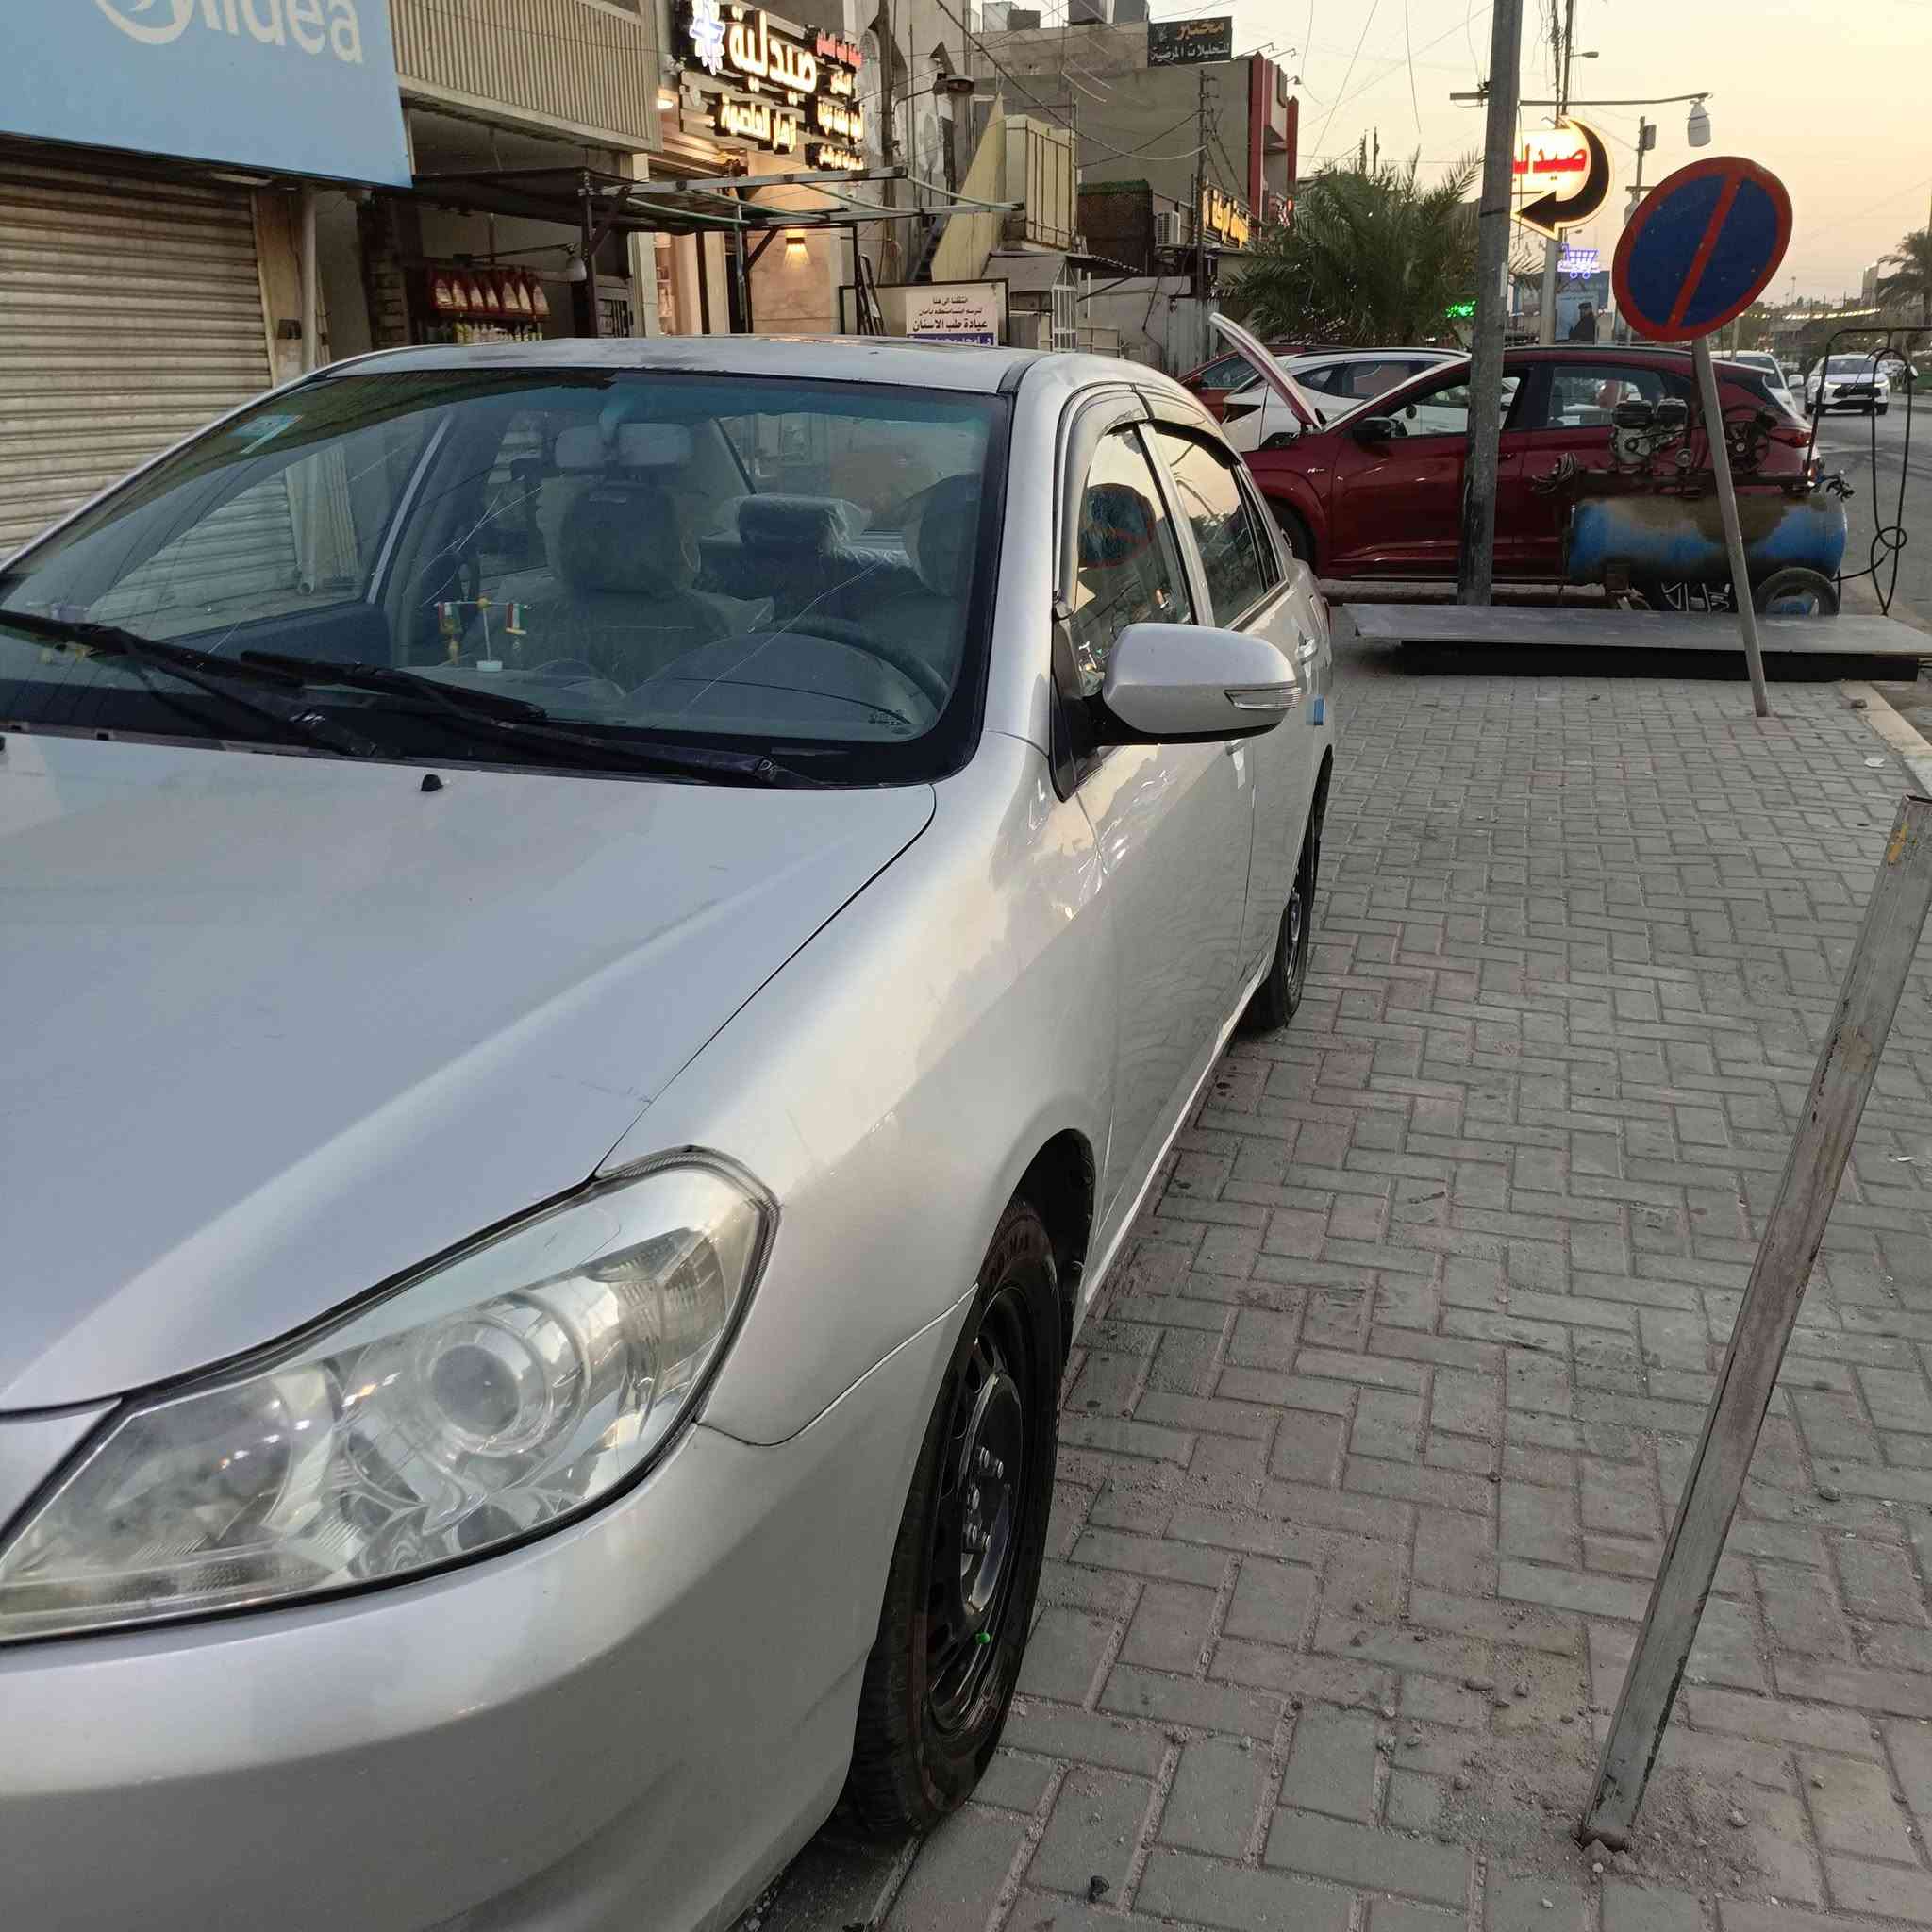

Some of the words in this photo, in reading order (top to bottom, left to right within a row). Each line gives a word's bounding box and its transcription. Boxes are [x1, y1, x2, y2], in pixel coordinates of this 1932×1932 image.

[1174, 21, 1224, 41] مختبر
[729, 5, 817, 107] صيدلية
[1150, 44, 1185, 63] المرضية
[1188, 41, 1230, 58] للتحليلات
[1511, 142, 1587, 182] صيدلي
[912, 319, 944, 332] الاسنان
[945, 319, 962, 332] طب
[963, 318, 988, 331] عيادة
